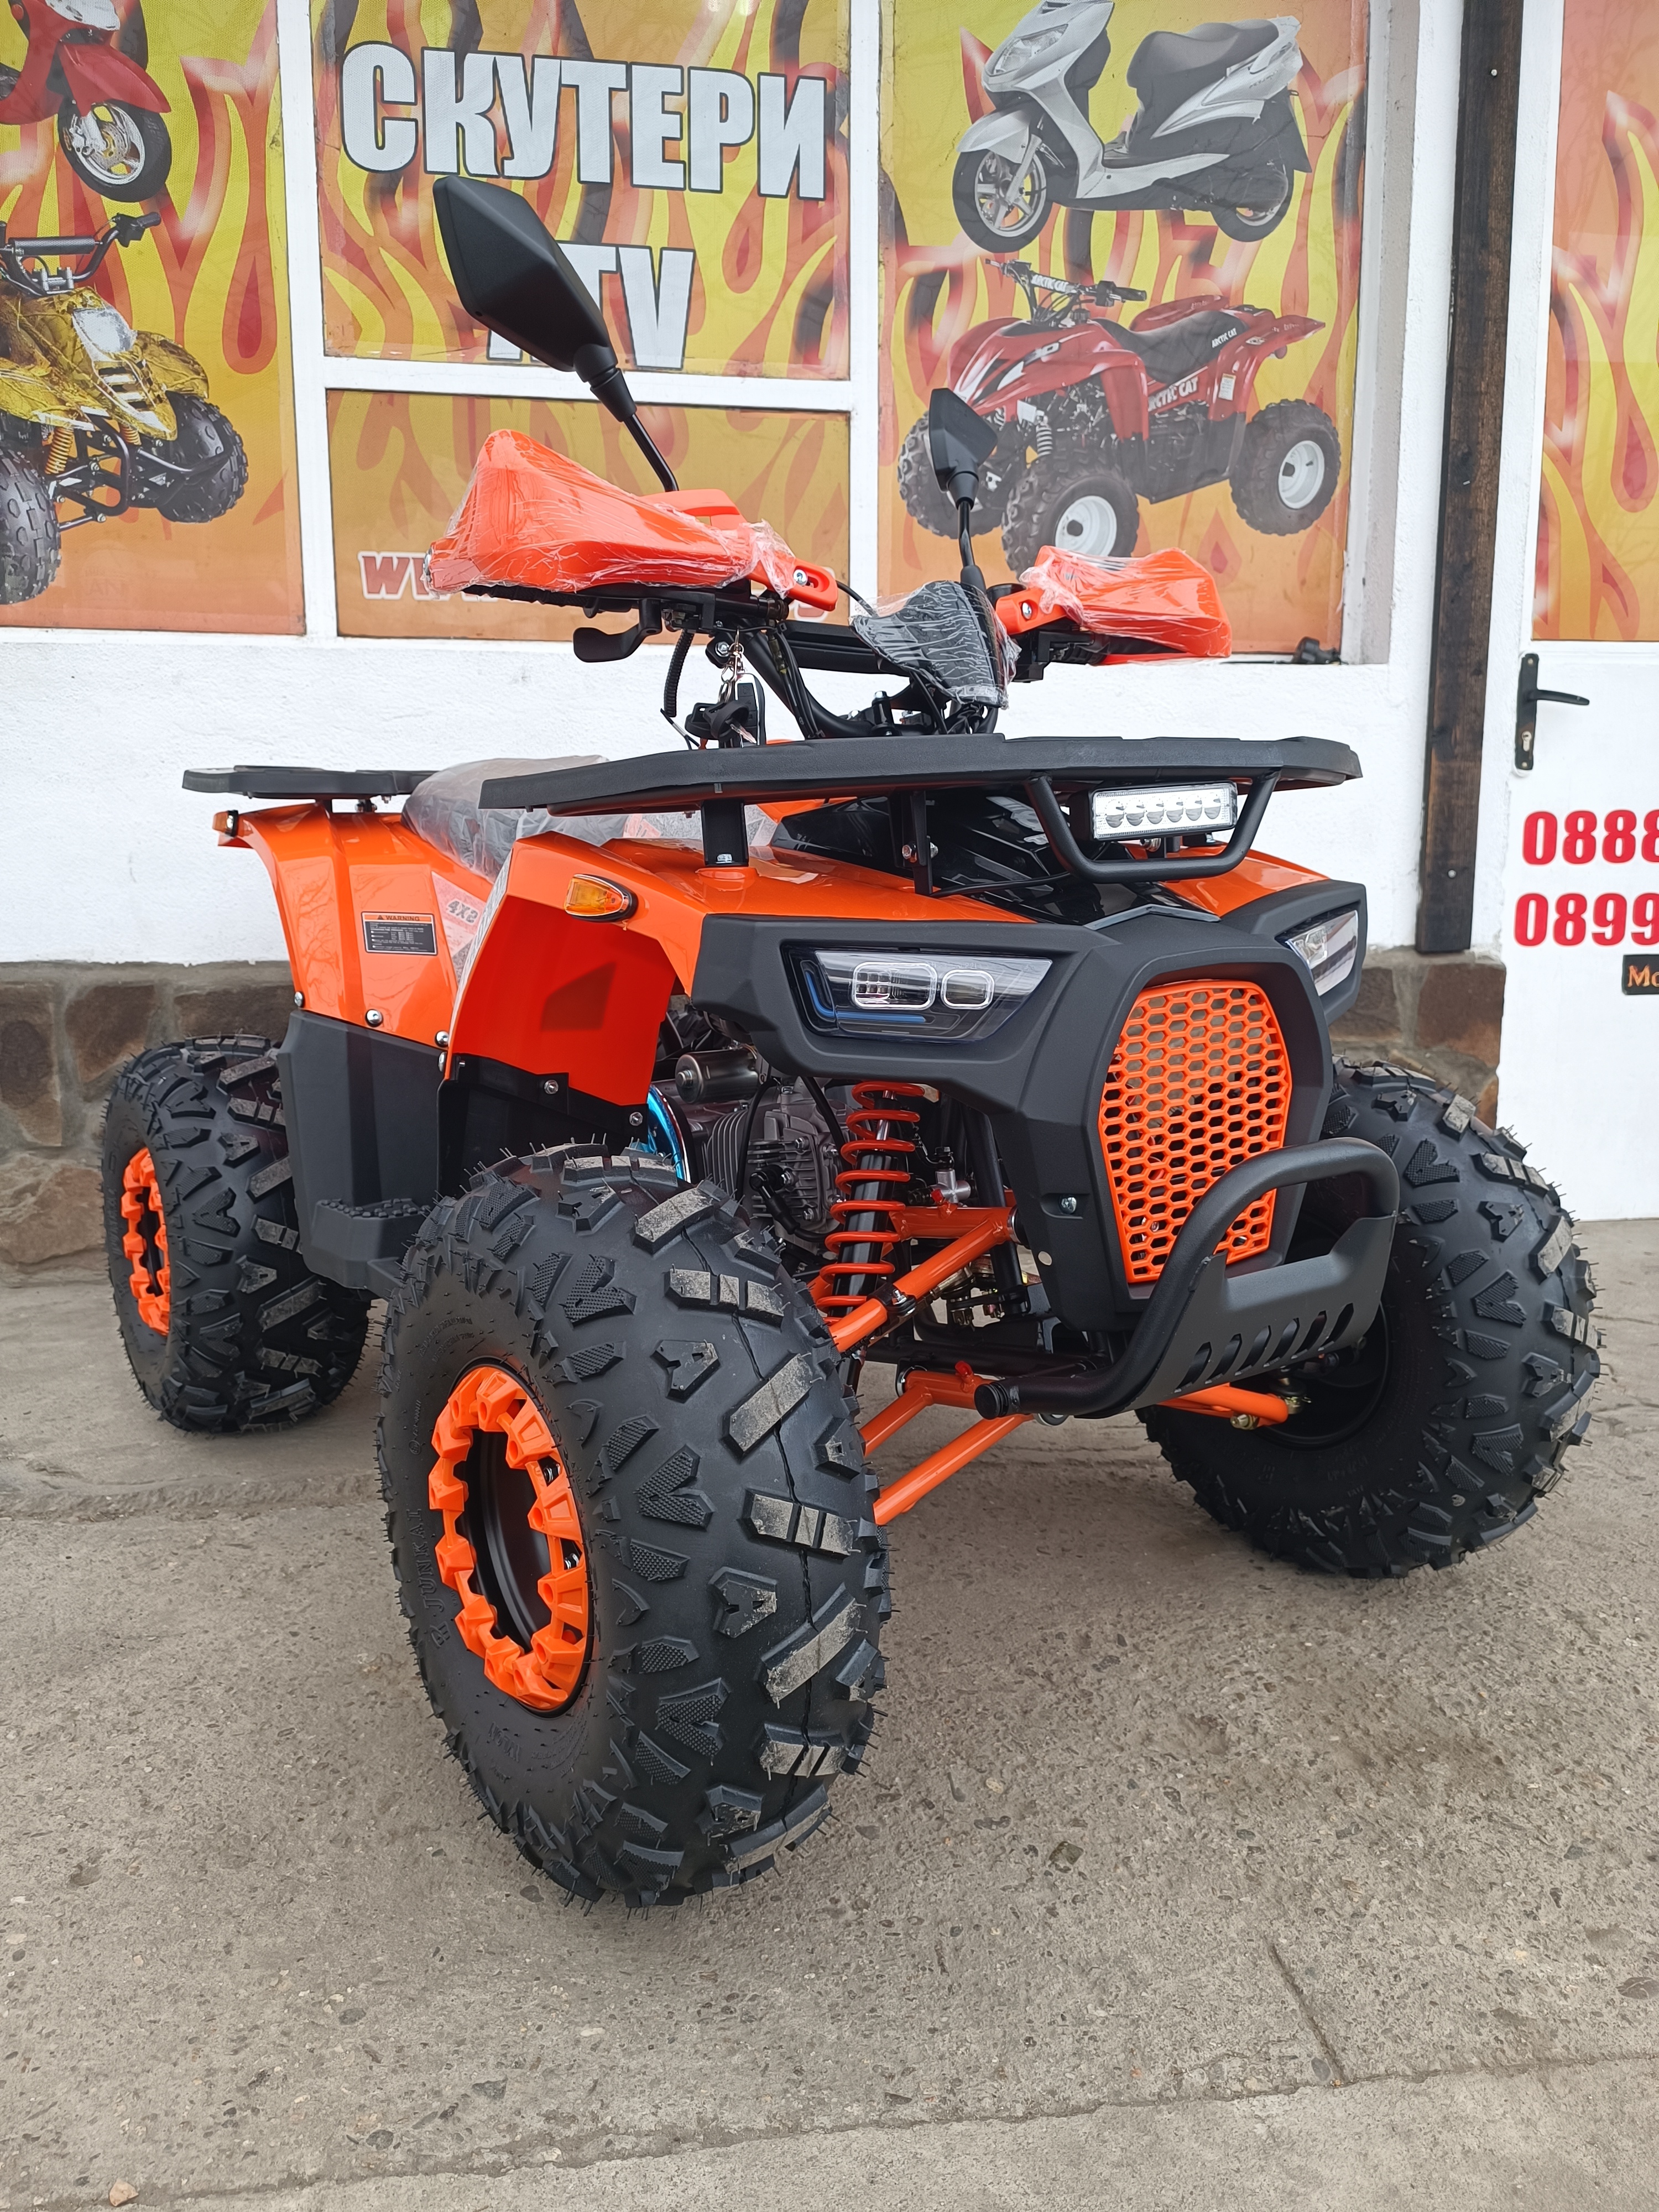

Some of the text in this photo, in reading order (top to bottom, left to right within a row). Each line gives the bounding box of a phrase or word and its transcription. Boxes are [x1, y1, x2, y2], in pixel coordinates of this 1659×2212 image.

[342, 41, 827, 200] СКУТЕРИ
[487, 240, 696, 371] TV
[1212, 327, 1237, 348] ARCTIC CAT
[1178, 376, 1198, 397] CAT
[447, 900, 479, 924] 4X2
[1514, 893, 1659, 947] 0899
[406, 1509, 445, 1613] JUNKAI
